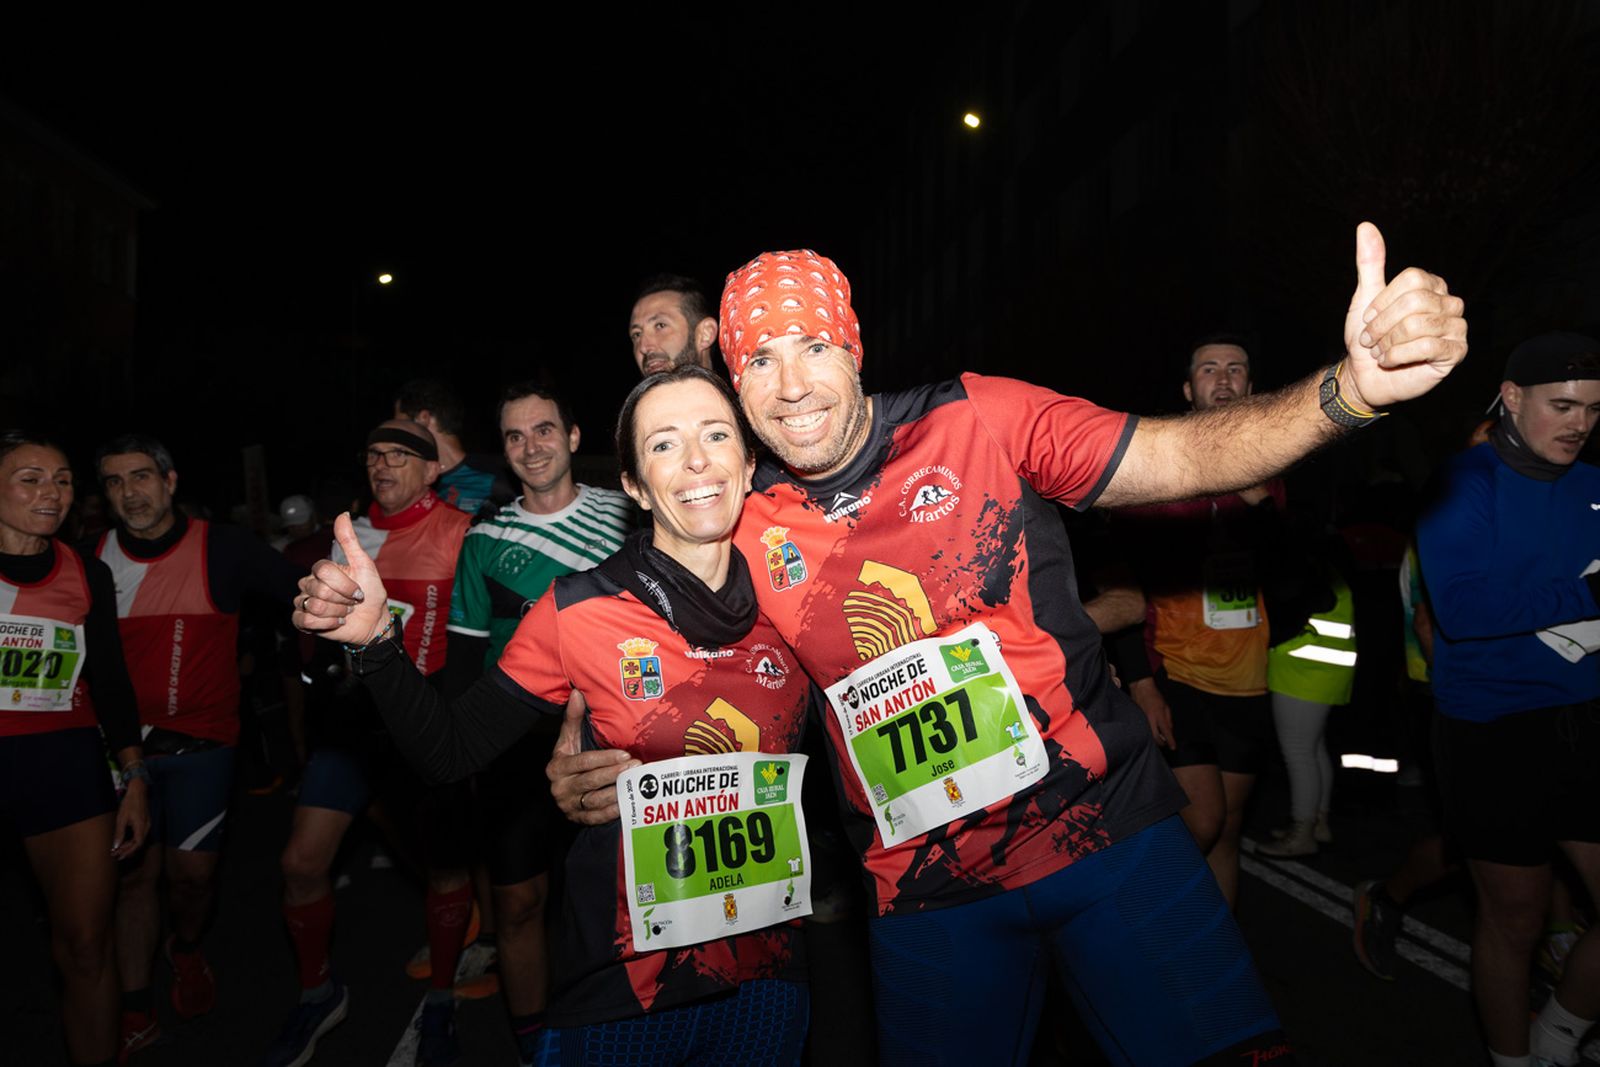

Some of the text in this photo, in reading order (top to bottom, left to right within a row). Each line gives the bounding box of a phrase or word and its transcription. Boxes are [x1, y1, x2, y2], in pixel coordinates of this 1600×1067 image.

[900, 465, 963, 495] CORRECAMINOS
[909, 495, 960, 523] Martos
[0, 624, 29, 636] OCHE
[30, 627, 45, 637] DE
[1, 635, 44, 648] ANTÓN
[0, 649, 63, 679] 020
[860, 668, 907, 704] NOCHE
[907, 658, 928, 681] DE
[854, 703, 881, 732] SAN
[884, 677, 937, 718] ANTÓN
[877, 687, 978, 775] 7737
[931, 759, 956, 777] Jose
[662, 771, 739, 797] NOCHE DE
[643, 789, 739, 824] SAN ANTÓN
[663, 811, 776, 879] 8169
[709, 872, 745, 891] ADELA
